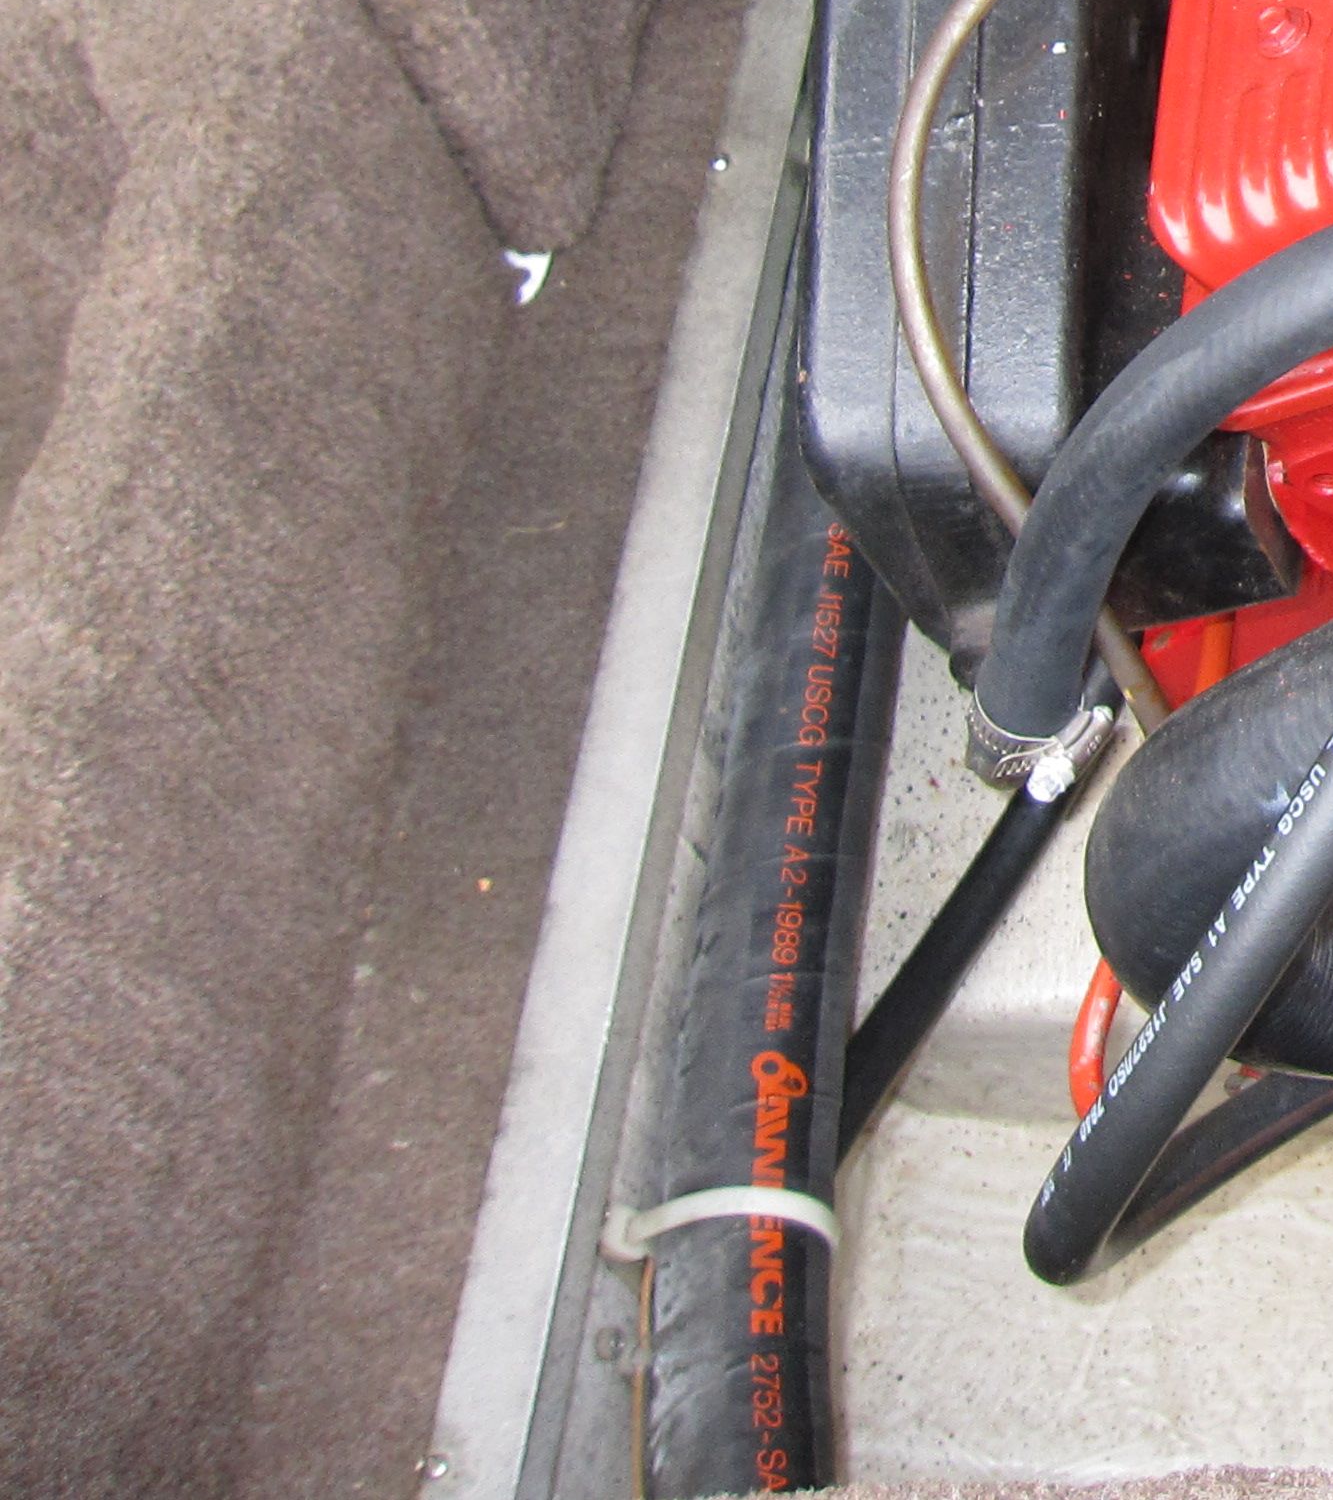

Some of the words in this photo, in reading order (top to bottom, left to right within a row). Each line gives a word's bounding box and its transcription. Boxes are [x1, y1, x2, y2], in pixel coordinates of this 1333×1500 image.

[822, 522, 853, 579] SAE
[812, 582, 842, 660] J1527
[798, 664, 835, 748] USCG
[785, 759, 823, 837] TYPE
[1276, 763, 1327, 836] USCG
[770, 843, 811, 967] A2-1989
[1231, 845, 1277, 911] TYPE
[1206, 911, 1229, 948] A1
[1171, 950, 1204, 1001] SAE
[750, 1050, 809, 1336] LAWENCE
